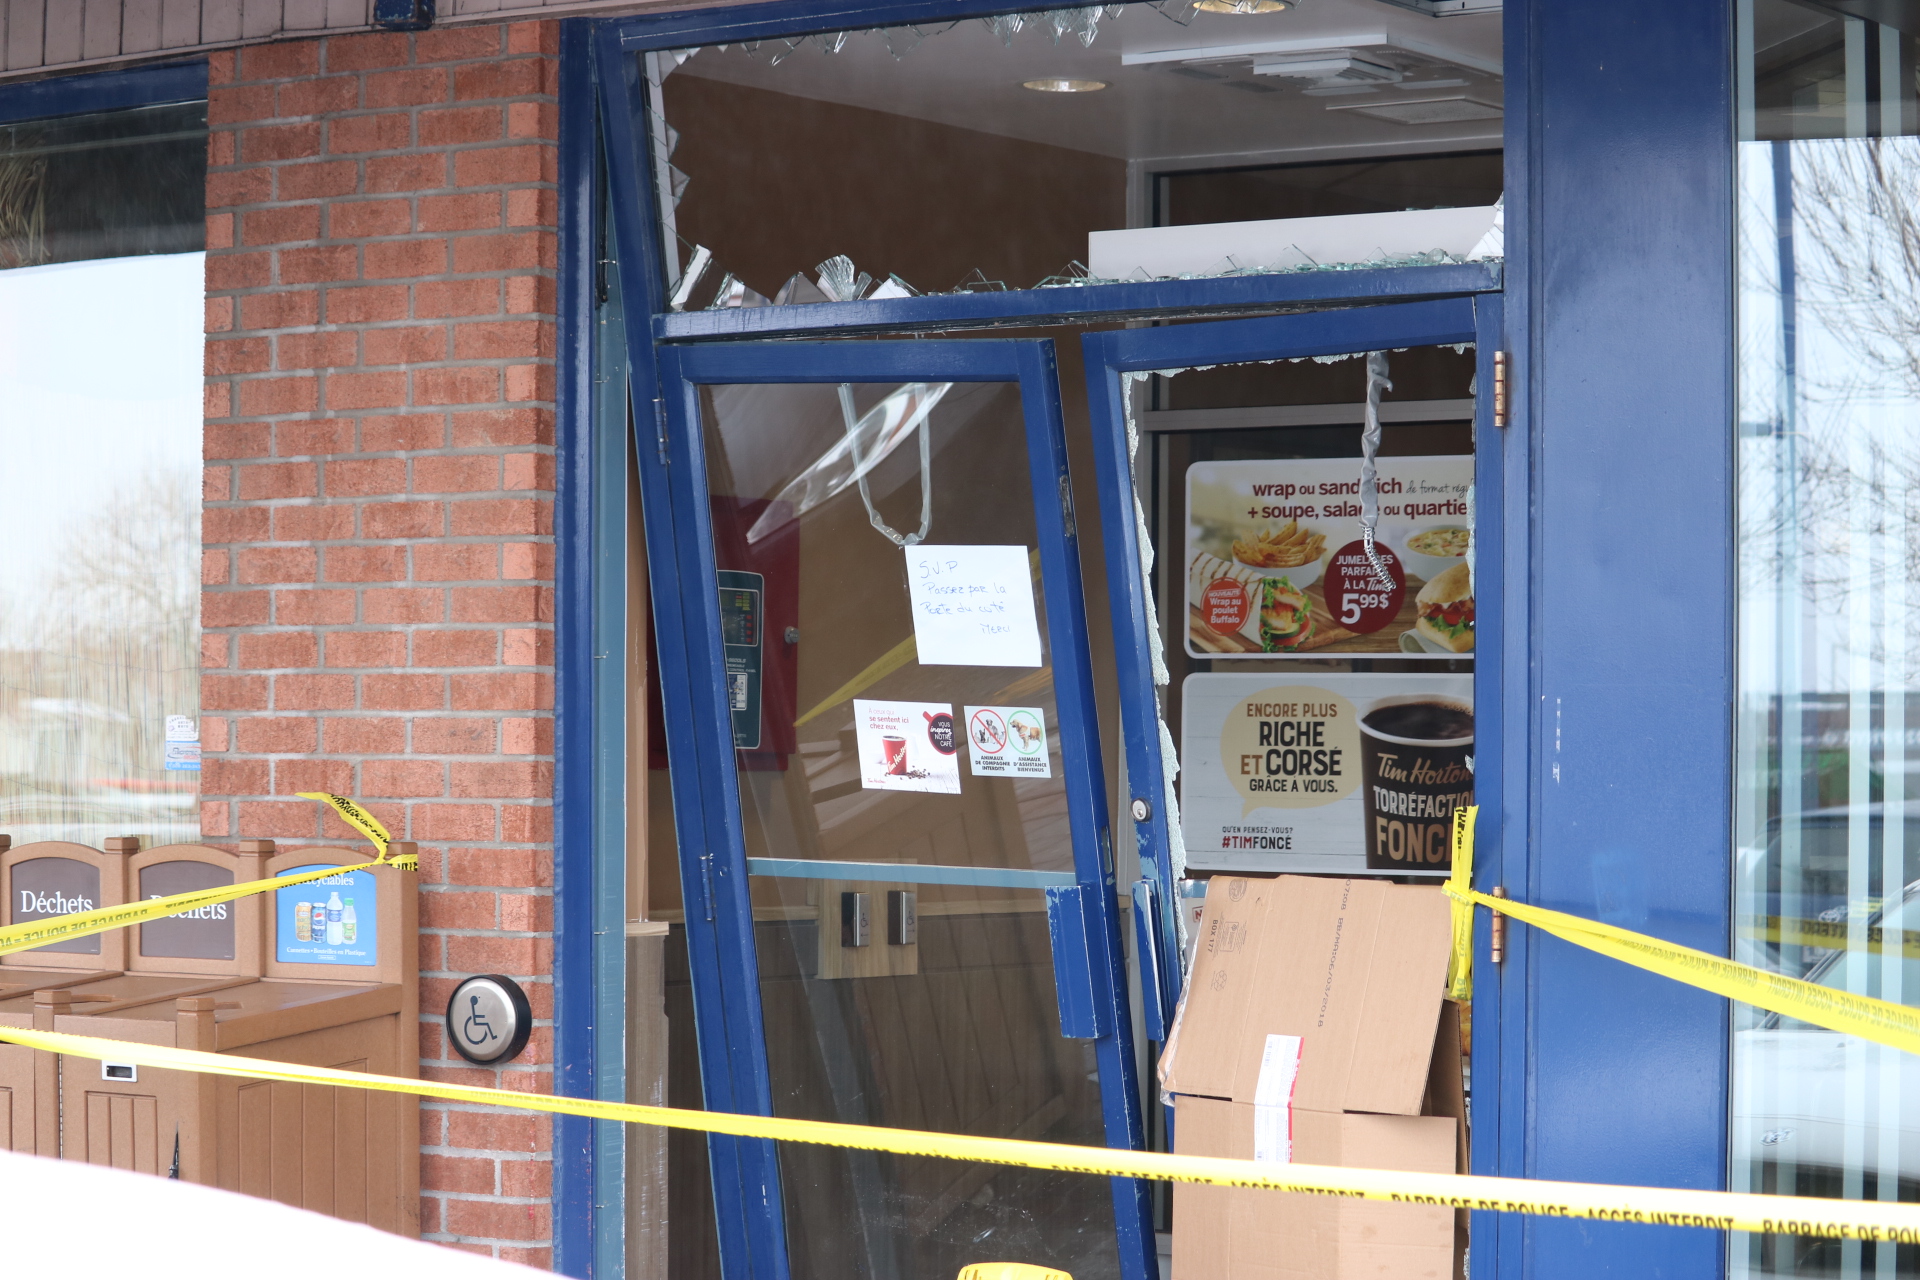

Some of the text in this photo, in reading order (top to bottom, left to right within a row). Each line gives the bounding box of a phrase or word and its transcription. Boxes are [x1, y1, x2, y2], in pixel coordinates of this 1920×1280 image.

[1252, 483, 1296, 500] wrap
[1299, 484, 1315, 495] ou
[1319, 477, 1402, 496] sandich
[1405, 480, 1418, 493] de
[1419, 479, 1451, 494] format
[1261, 504, 1319, 521] soupe,
[1323, 501, 1380, 517] sala
[1383, 505, 1400, 516] ou
[1341, 566, 1388, 576] PARFAI
[1343, 577, 1351, 589] À
[1353, 579, 1366, 589] LA
[956, 602, 973, 613] du
[1210, 598, 1230, 607] Wrap
[1212, 606, 1239, 616] poulet
[1210, 615, 1240, 624] Buffalo
[886, 708, 895, 716] qui
[1247, 703, 1337, 718] ENCORE PLUS
[869, 722, 884, 730] chez
[1259, 721, 1325, 747] RICHE
[1240, 746, 1342, 776] ET CORSÉ
[1377, 752, 1473, 785] Tim Horton
[1249, 775, 1287, 792] GRÂCE
[1303, 779, 1338, 793] VOUS.
[1373, 785, 1473, 818] TORRÉFACTIO
[1222, 826, 1294, 834] QU'EN PENSEZ-VOUS?
[1222, 835, 1292, 850] #TIMFONCÉ
[20, 889, 94, 914] Déchets
[1207, 919, 1219, 953] BOX 177
